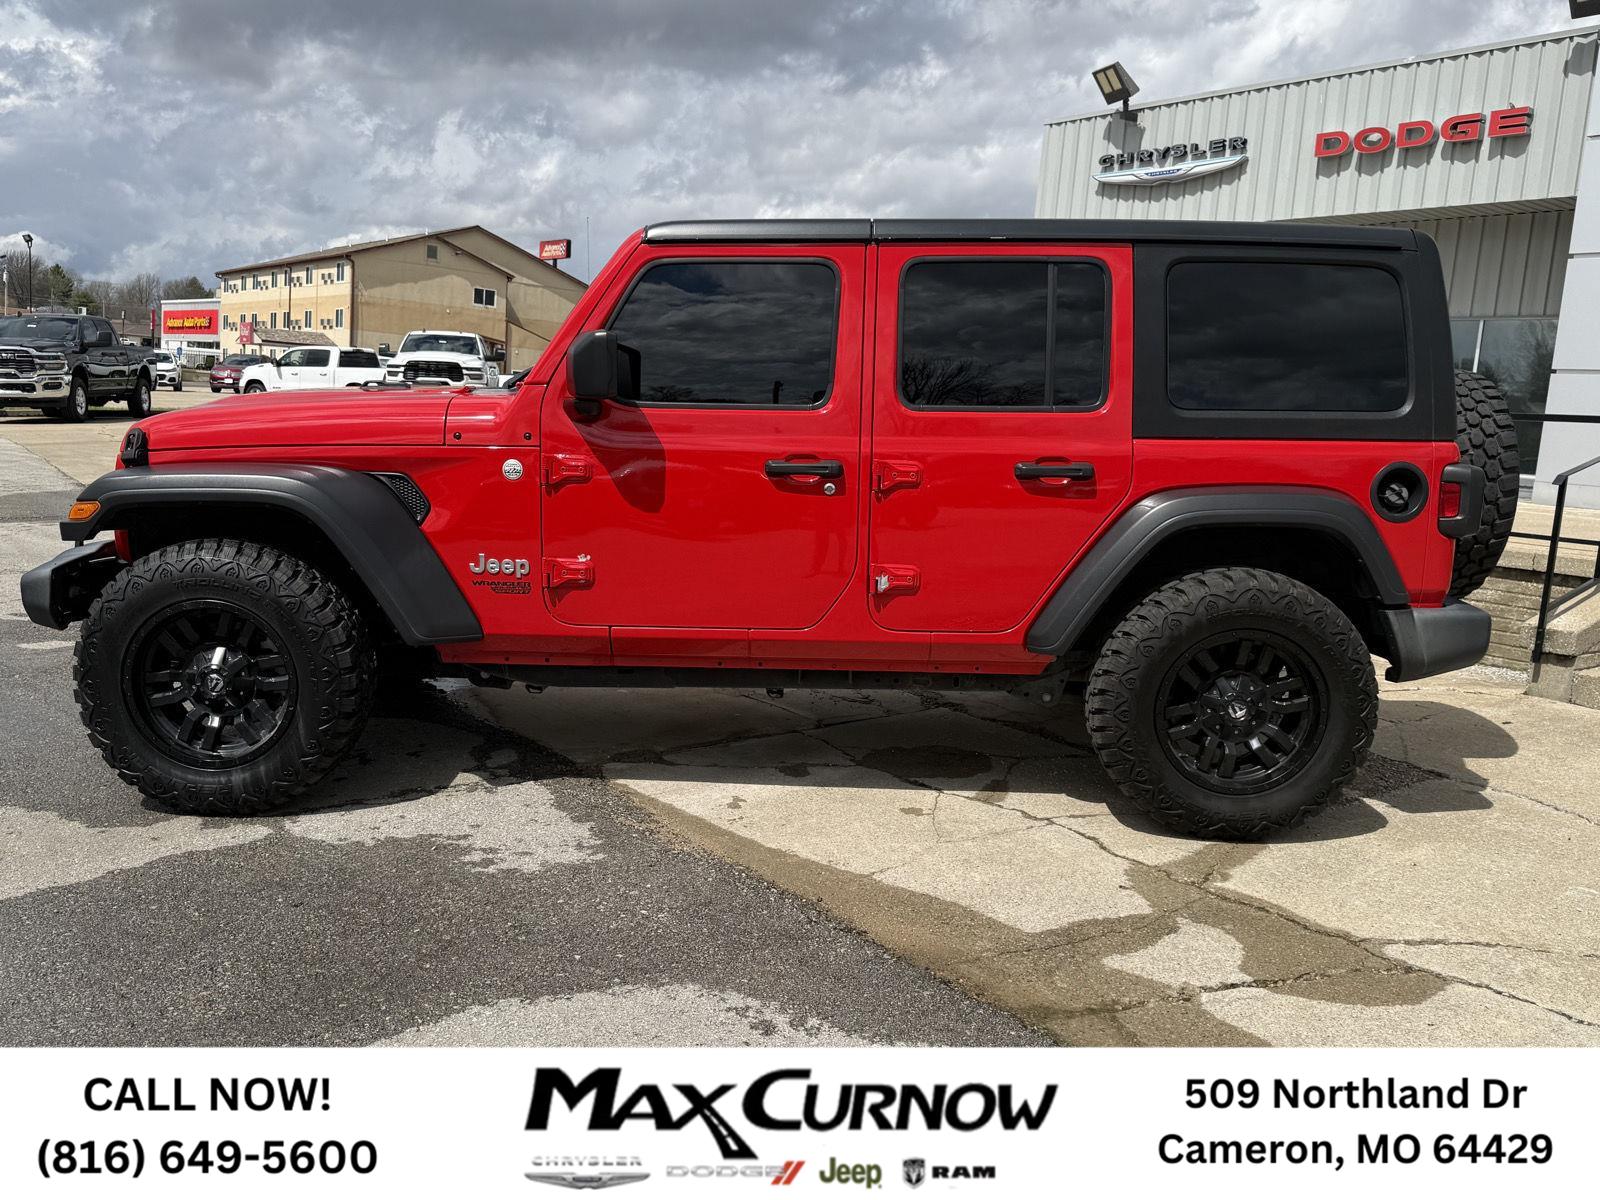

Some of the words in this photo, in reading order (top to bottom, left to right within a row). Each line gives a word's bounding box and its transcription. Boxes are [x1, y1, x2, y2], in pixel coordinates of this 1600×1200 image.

[1315, 106, 1533, 158] DODGE
[1099, 136, 1248, 168] CHRYSLER
[469, 553, 530, 579] Jeep
